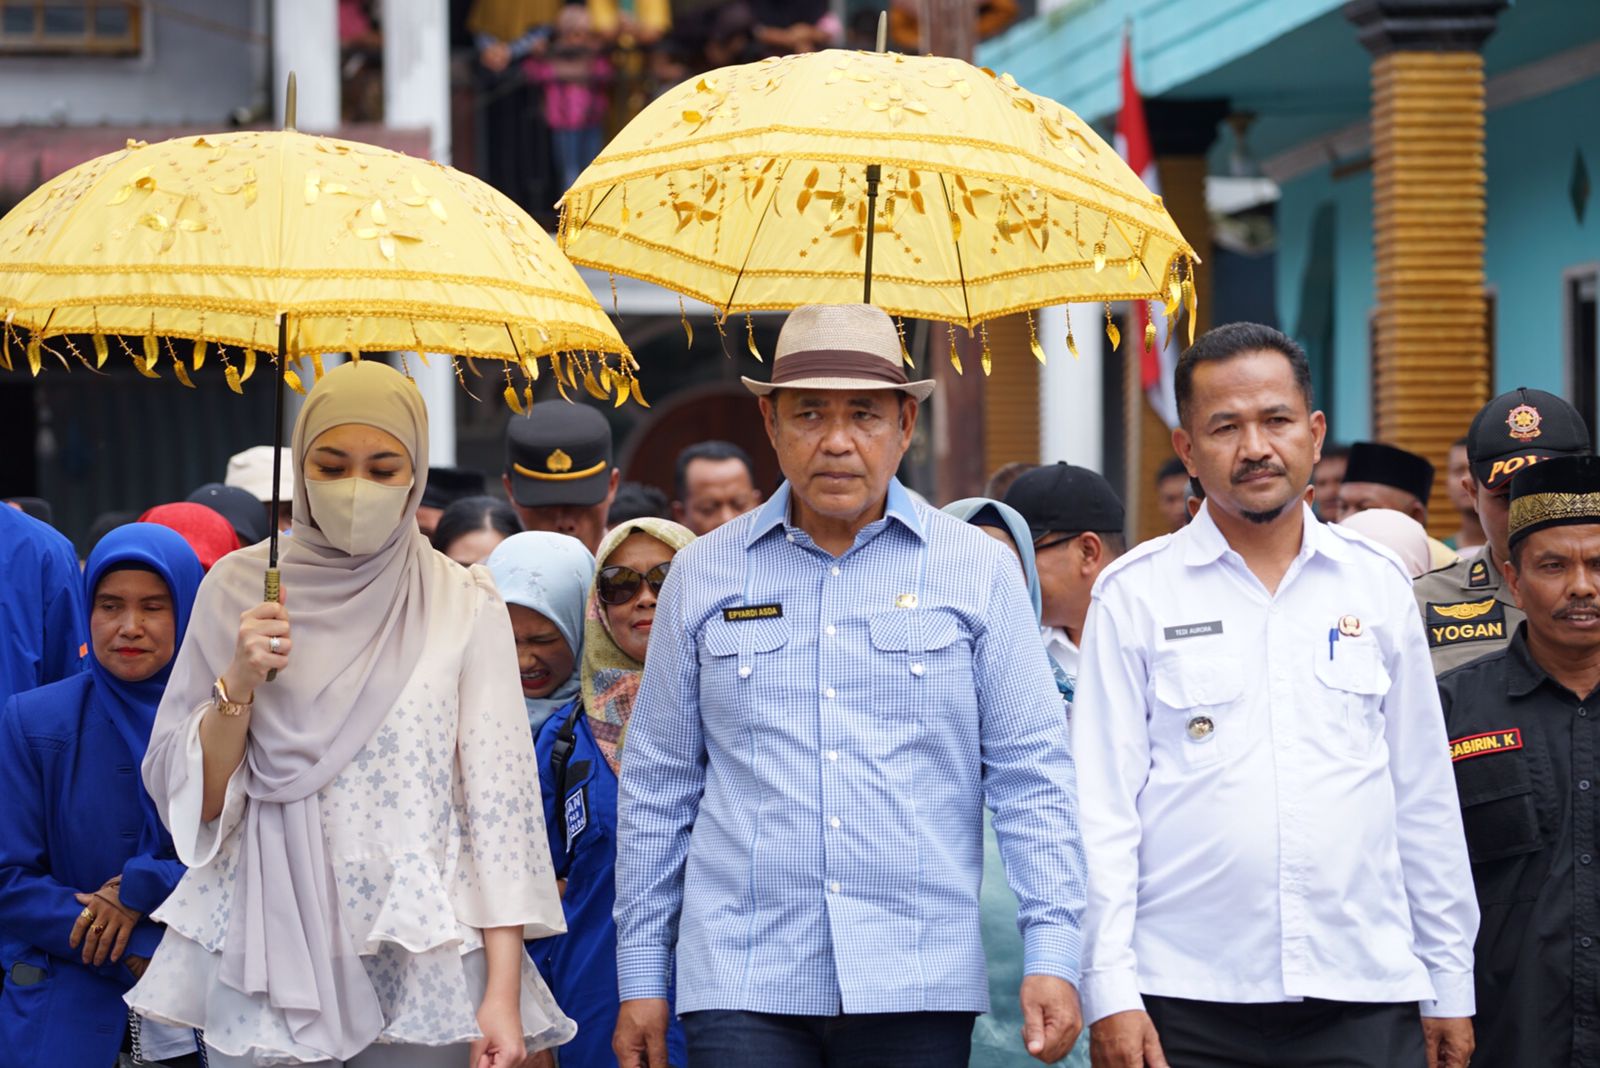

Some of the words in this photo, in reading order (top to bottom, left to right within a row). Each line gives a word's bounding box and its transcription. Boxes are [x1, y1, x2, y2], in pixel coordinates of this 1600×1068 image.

[759, 607, 778, 616] ASDA
[1432, 622, 1502, 643] YOGAN
[1503, 733, 1515, 746] K
